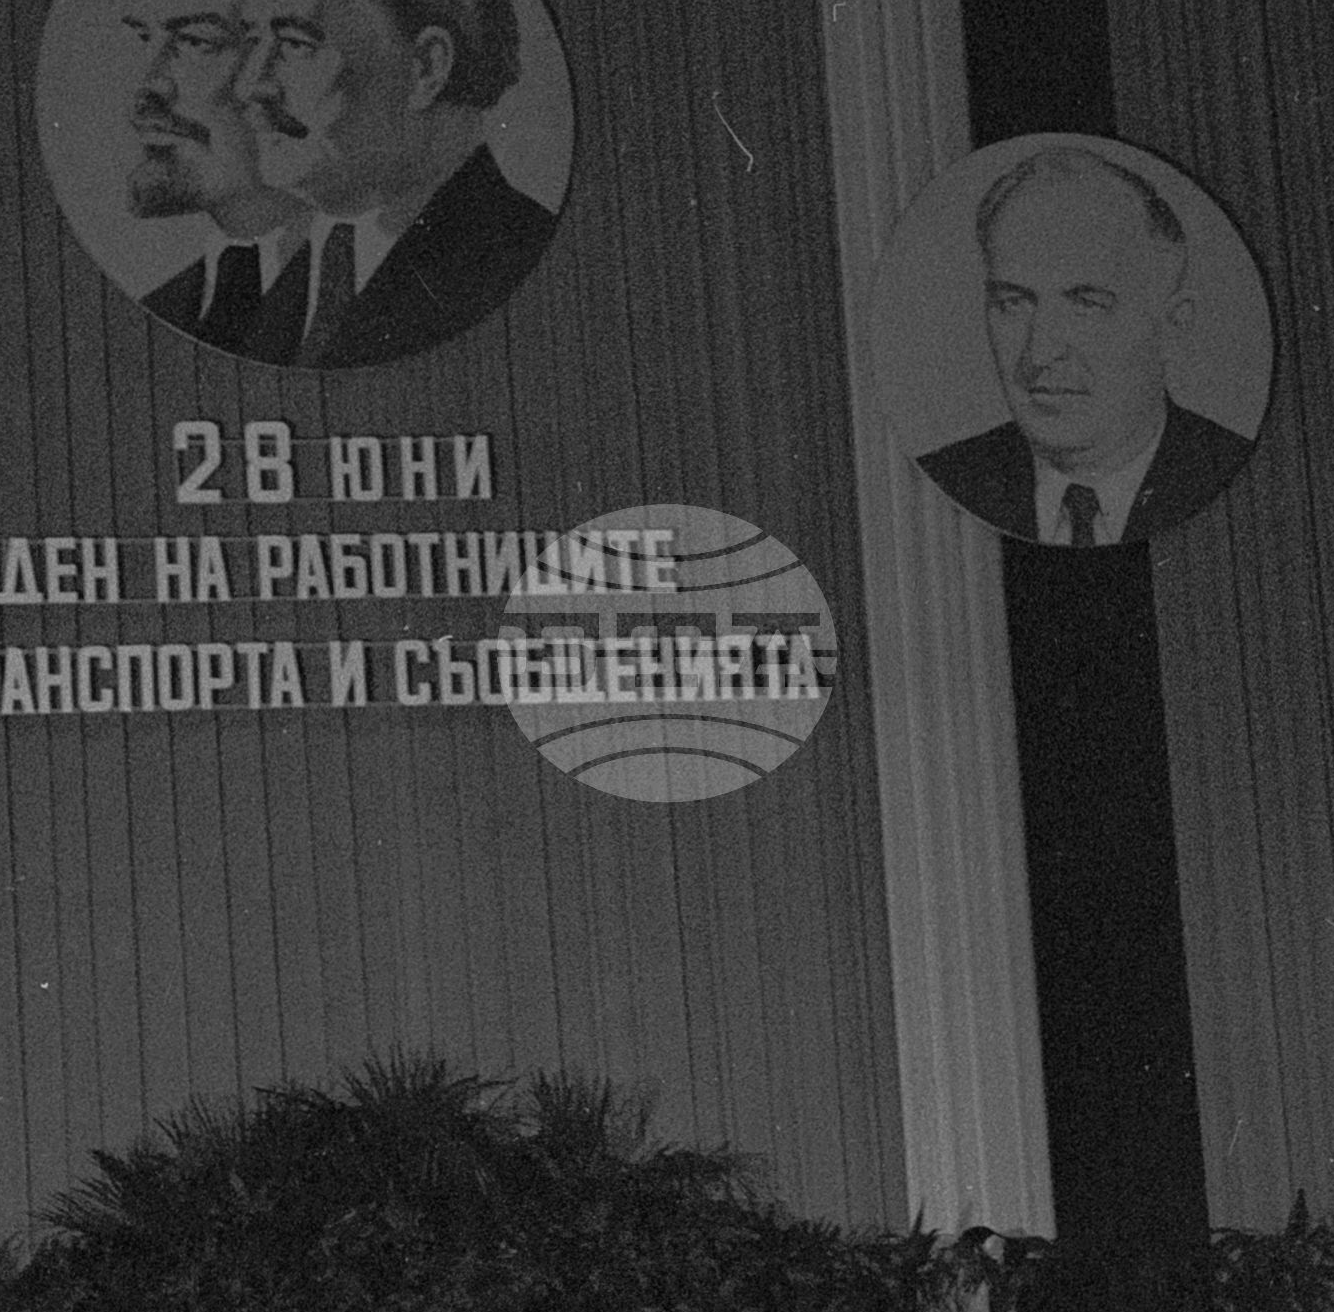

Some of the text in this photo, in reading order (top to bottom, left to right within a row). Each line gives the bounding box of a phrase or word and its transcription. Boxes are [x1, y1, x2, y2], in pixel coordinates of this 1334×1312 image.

[173, 421, 492, 503] 28 ЮНИ
[154, 536, 231, 602] НА
[257, 529, 678, 601] РАБОТНИЦИТЕ
[329, 640, 367, 708] И
[395, 633, 822, 706] СЪОБЩЕНИЯТА
